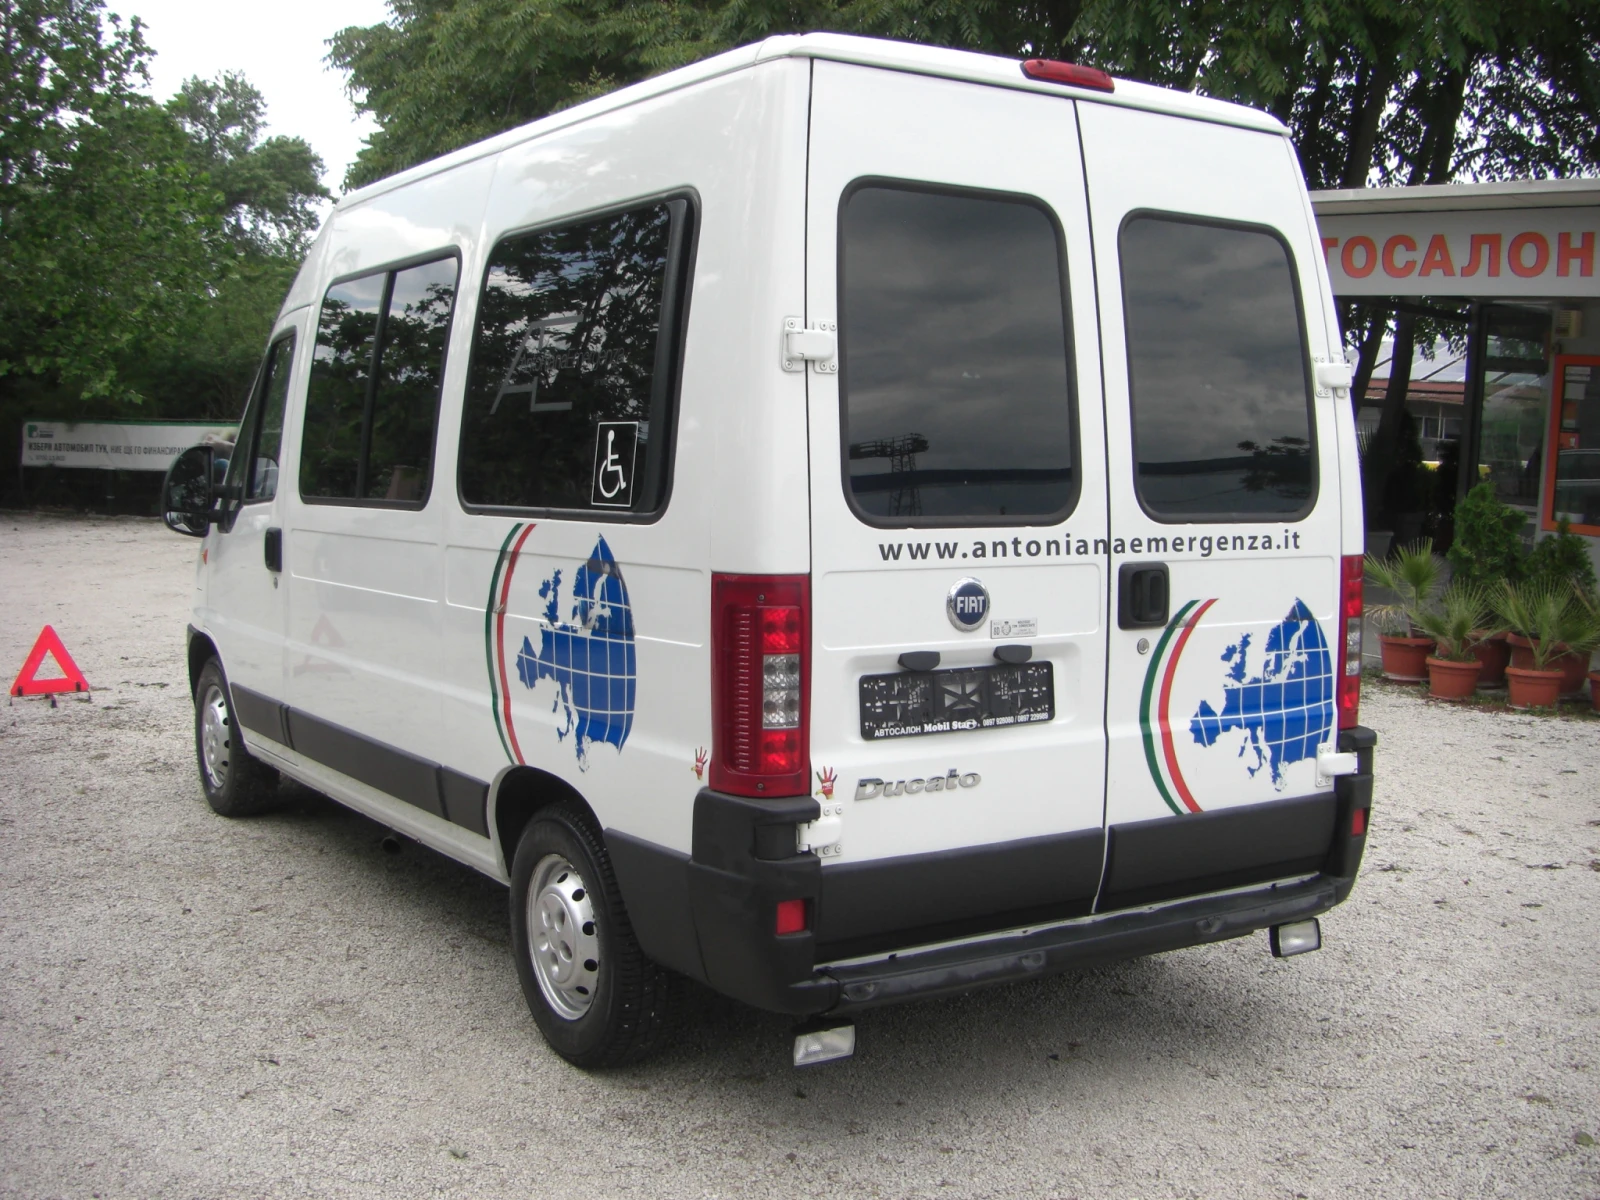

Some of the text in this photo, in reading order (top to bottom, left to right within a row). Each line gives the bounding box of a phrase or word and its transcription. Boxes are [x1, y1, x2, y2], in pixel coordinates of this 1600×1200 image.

[54, 442, 94, 453] АВТОМОБИЛ
[878, 528, 1301, 561] www.antonianaemergenza.it
[956, 595, 985, 614] FIAT
[874, 725, 921, 738] АВТОСАЛОН
[923, 723, 951, 733] Mobil
[854, 768, 982, 801] Ducato
